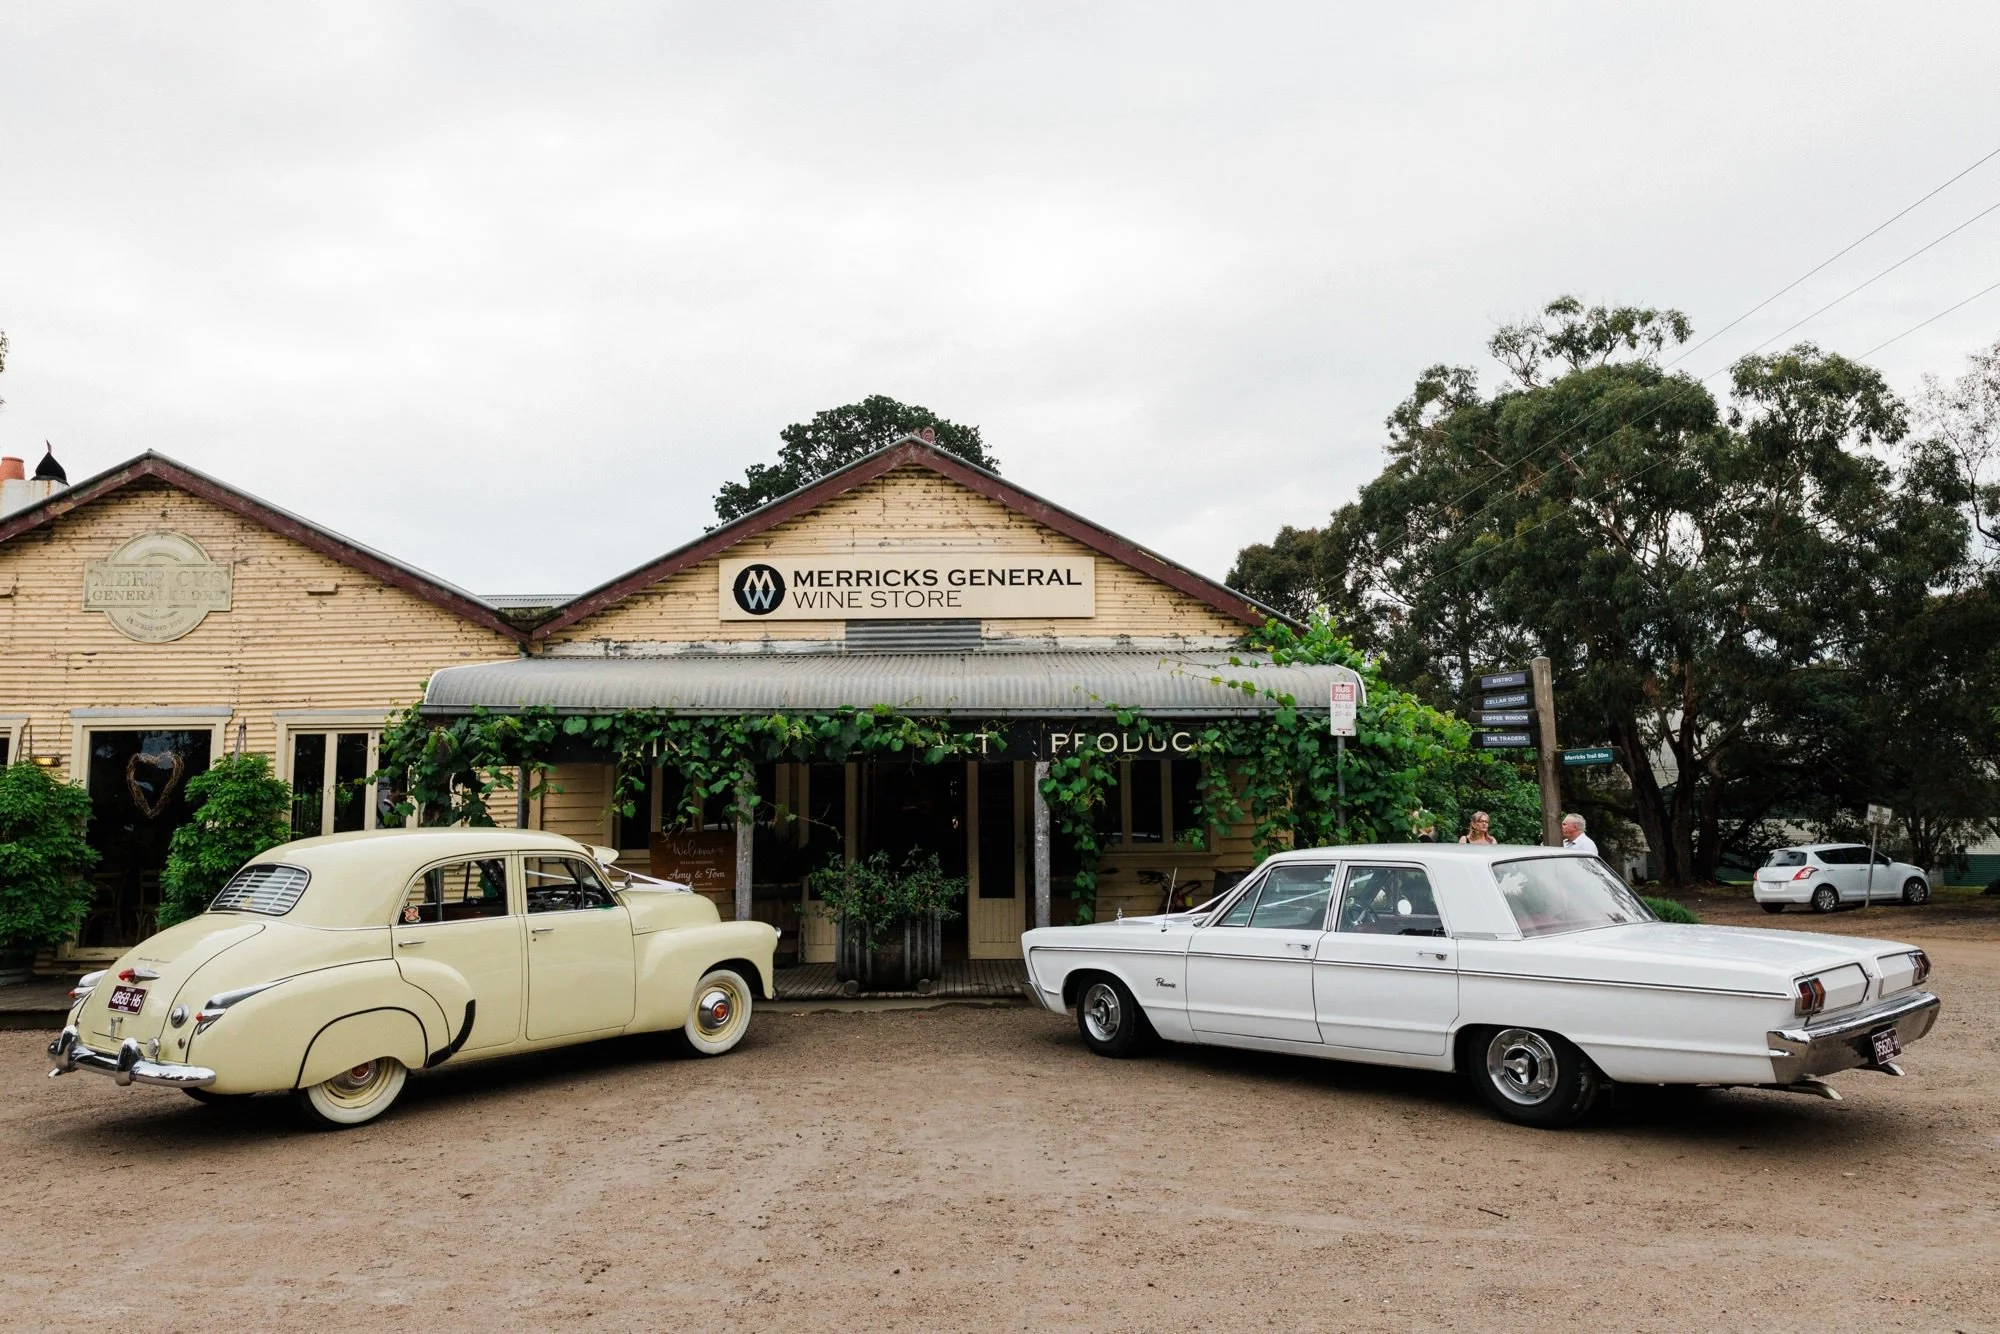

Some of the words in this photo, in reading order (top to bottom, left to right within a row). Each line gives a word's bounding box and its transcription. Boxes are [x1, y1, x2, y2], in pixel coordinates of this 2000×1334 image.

[93, 570, 223, 588] MERRCKS
[793, 569, 938, 588] MERRICKS
[947, 568, 1082, 587] GENERAL
[92, 590, 167, 601] GENERAL
[792, 590, 863, 609] WINE
[870, 589, 962, 609] STORE
[1485, 697, 1506, 705] CELLAR
[1051, 732, 1200, 753] PODUC
[667, 868, 692, 882] Amy
[694, 870, 703, 879] &
[705, 868, 726, 879] Tom
